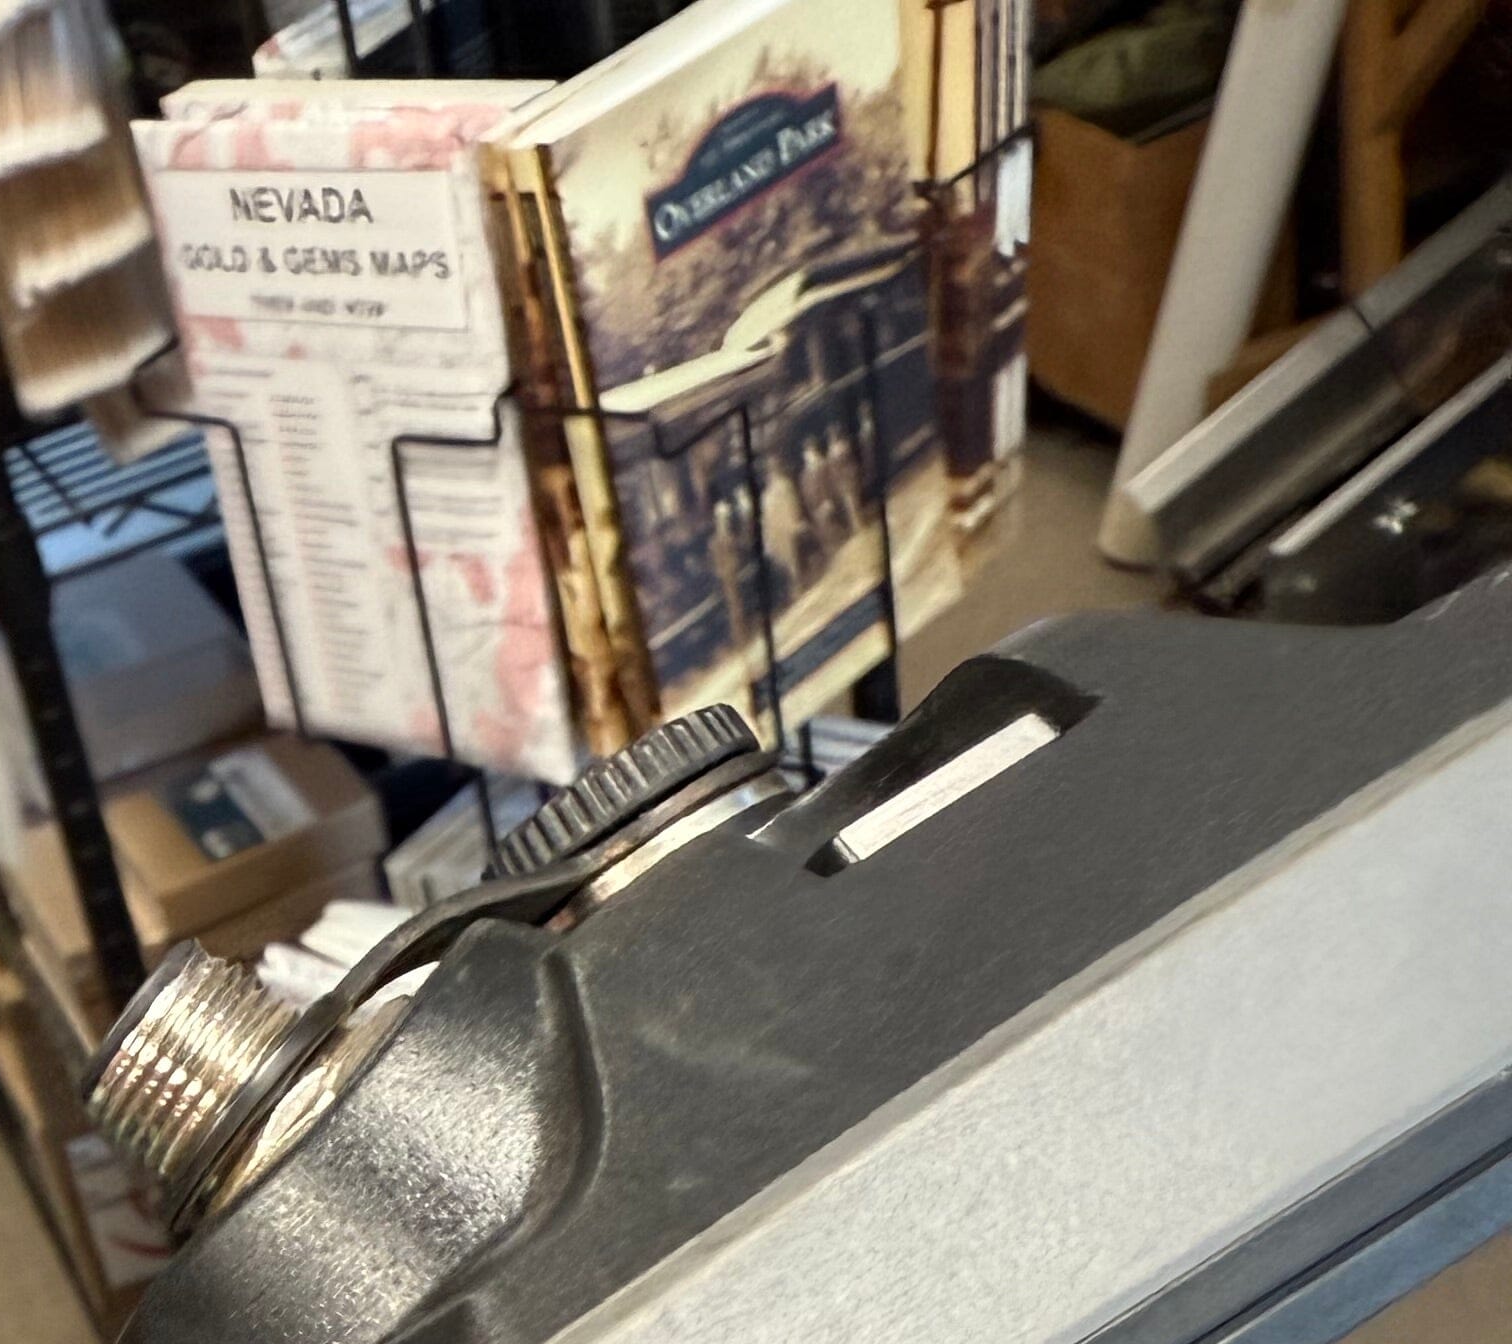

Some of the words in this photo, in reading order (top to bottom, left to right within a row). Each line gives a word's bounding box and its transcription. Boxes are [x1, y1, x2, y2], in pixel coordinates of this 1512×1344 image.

[229, 186, 374, 223] NEVADA
[182, 242, 249, 273] GOLD
[258, 246, 277, 273] &
[283, 246, 363, 277] GEMS
[369, 249, 451, 280] MAPS
